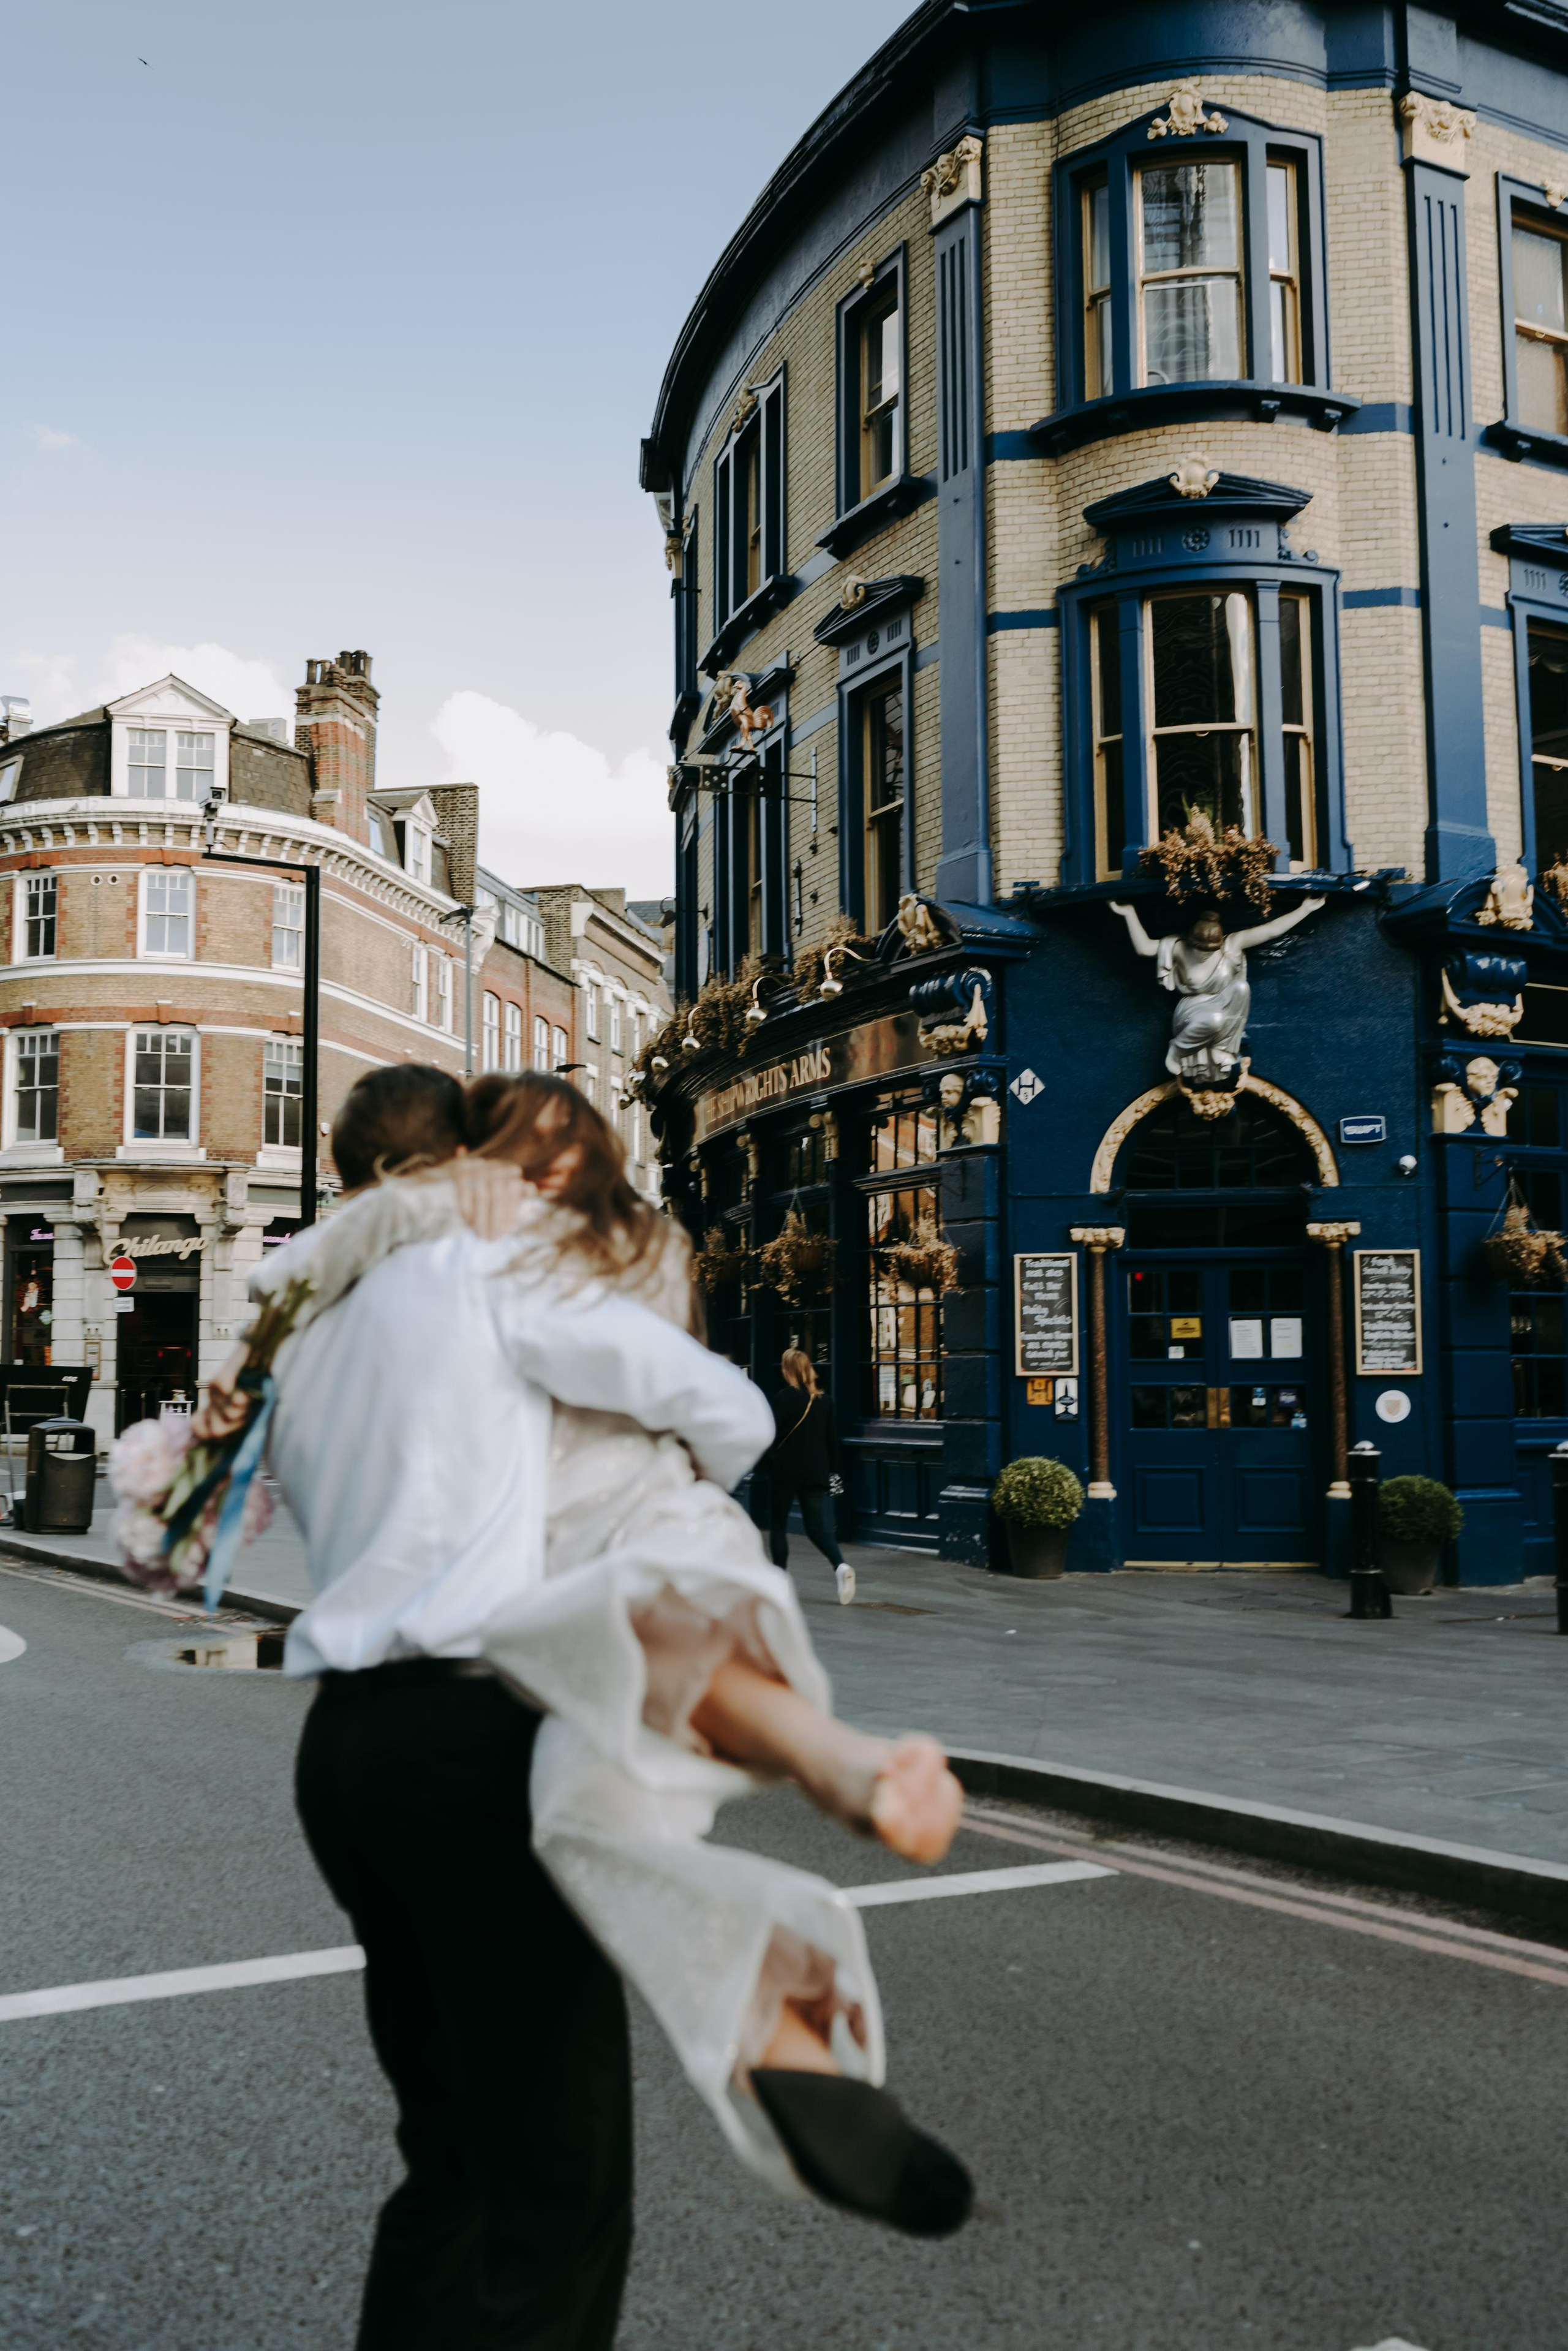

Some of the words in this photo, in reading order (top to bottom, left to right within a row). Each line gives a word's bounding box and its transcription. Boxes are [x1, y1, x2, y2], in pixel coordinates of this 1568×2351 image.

[789, 1047, 832, 1089] ARMS
[1017, 1076, 1036, 1096] H
[102, 1234, 209, 1266] Chilango
